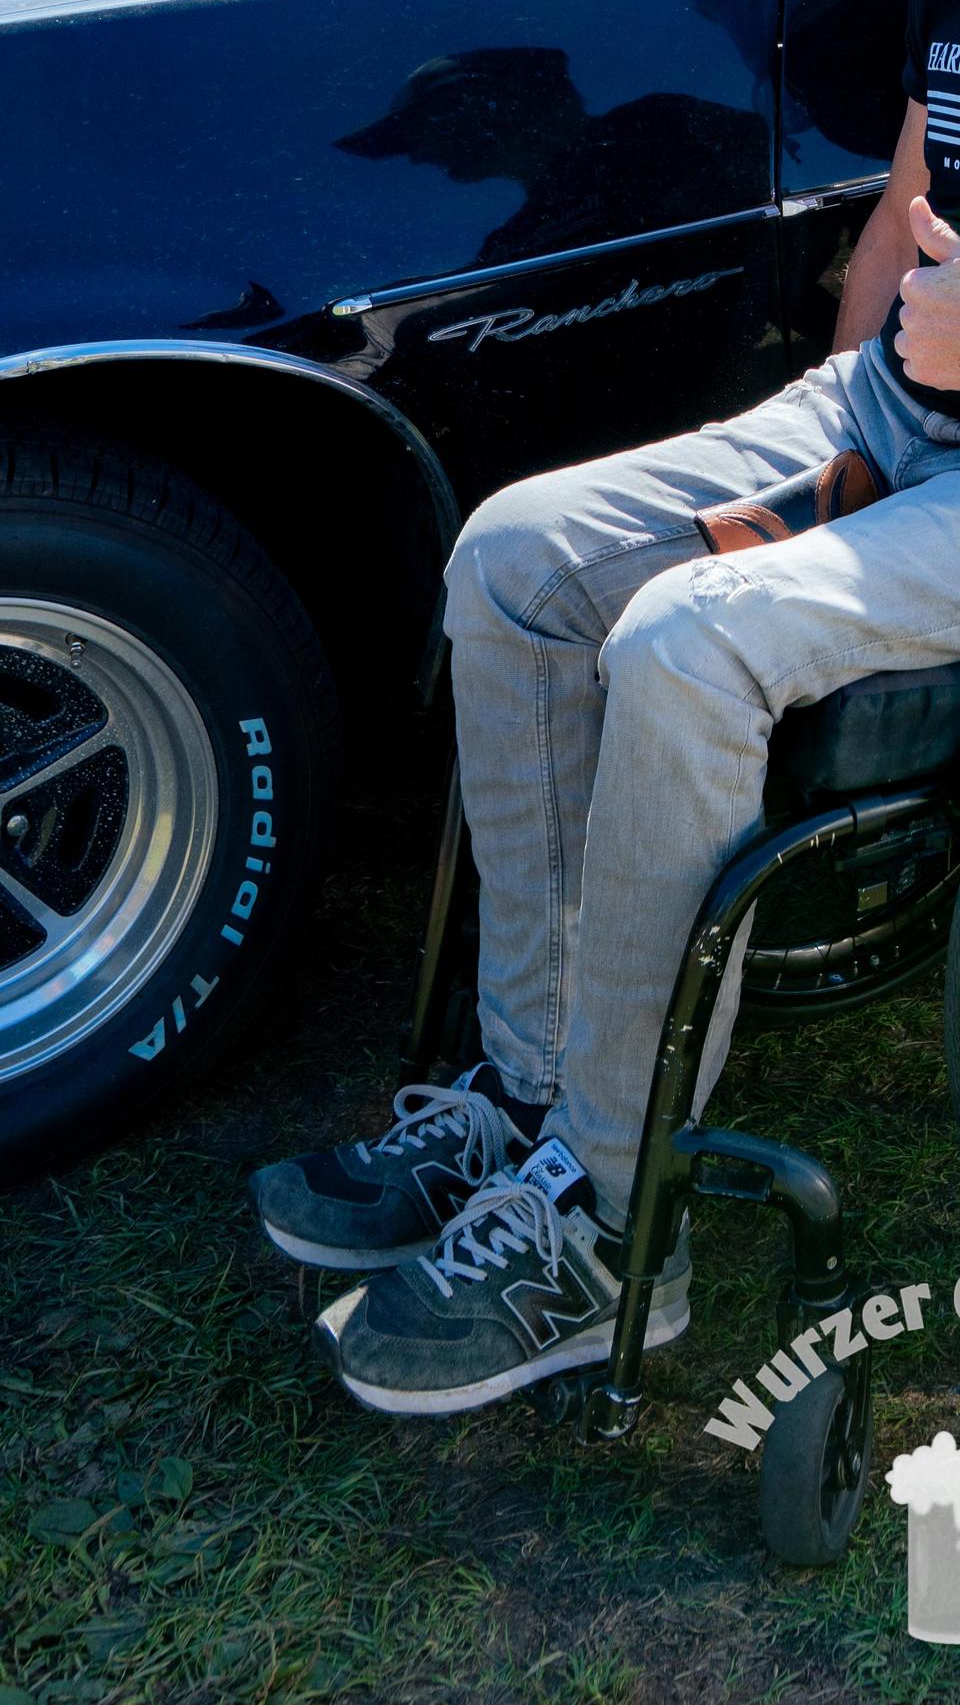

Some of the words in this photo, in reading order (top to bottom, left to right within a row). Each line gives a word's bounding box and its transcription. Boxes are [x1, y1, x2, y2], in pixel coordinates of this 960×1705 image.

[427, 266, 745, 352] Ranchero
[220, 717, 277, 946] Radial
[128, 973, 220, 1061] T/A
